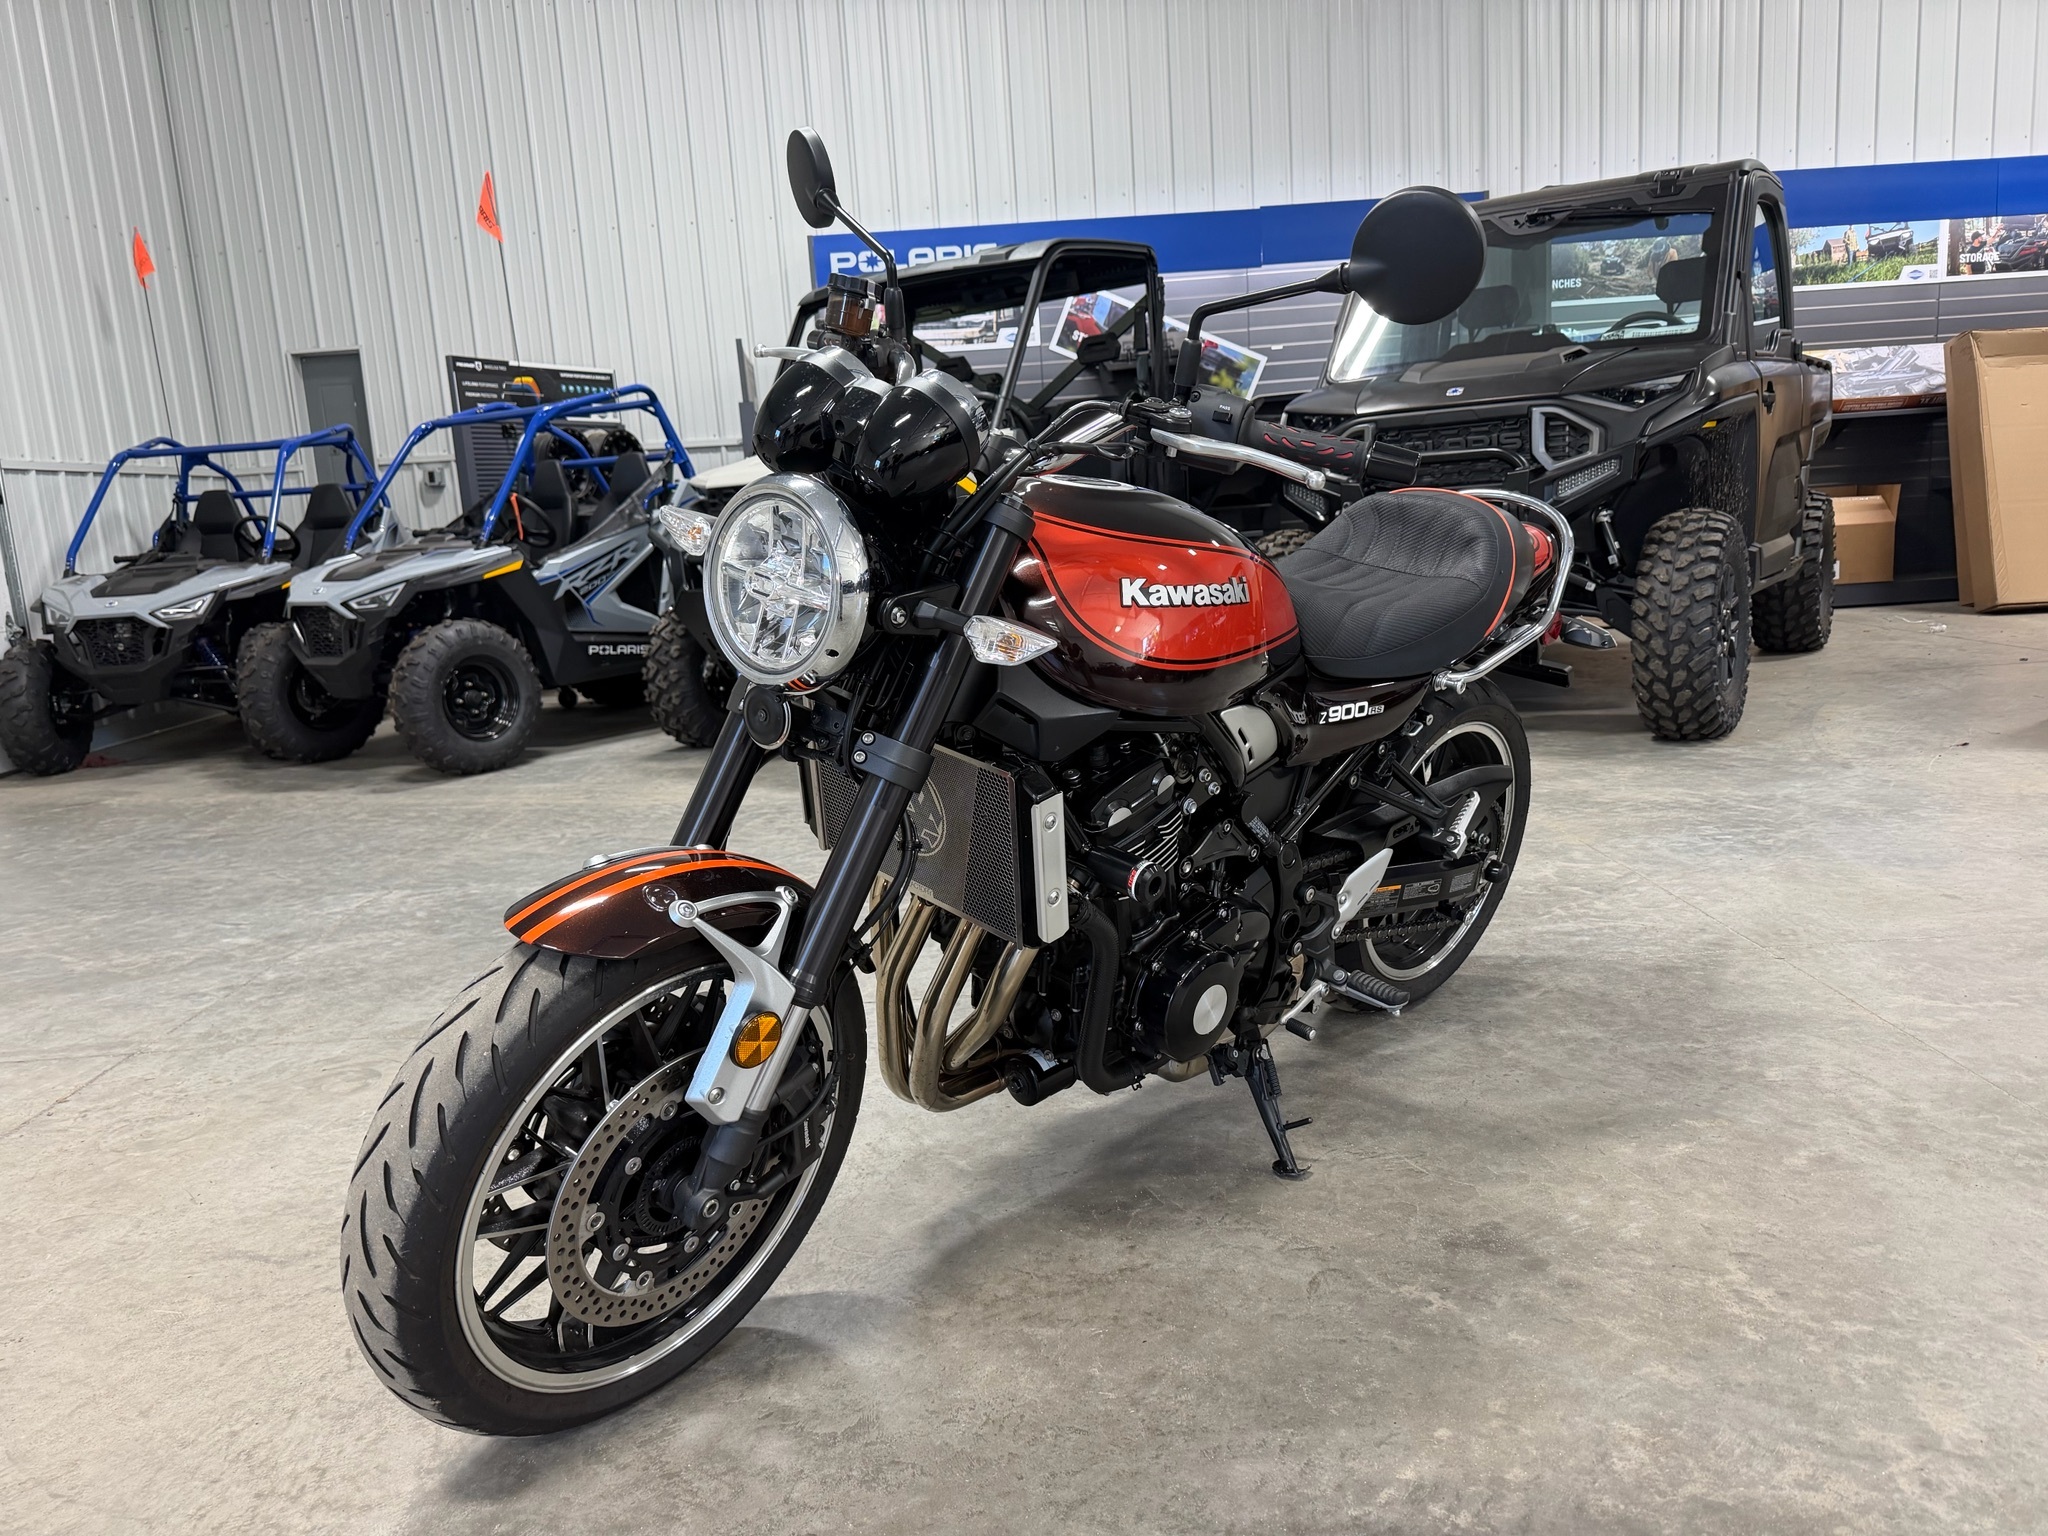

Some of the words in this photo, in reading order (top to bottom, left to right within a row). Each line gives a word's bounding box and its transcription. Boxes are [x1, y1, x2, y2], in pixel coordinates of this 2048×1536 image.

[829, 243, 997, 273] POLARI
[1959, 252, 2000, 263] STORAGE
[1552, 277, 1582, 290] NCHES
[553, 540, 638, 601] RZR
[1120, 576, 1250, 608] Kawasaki
